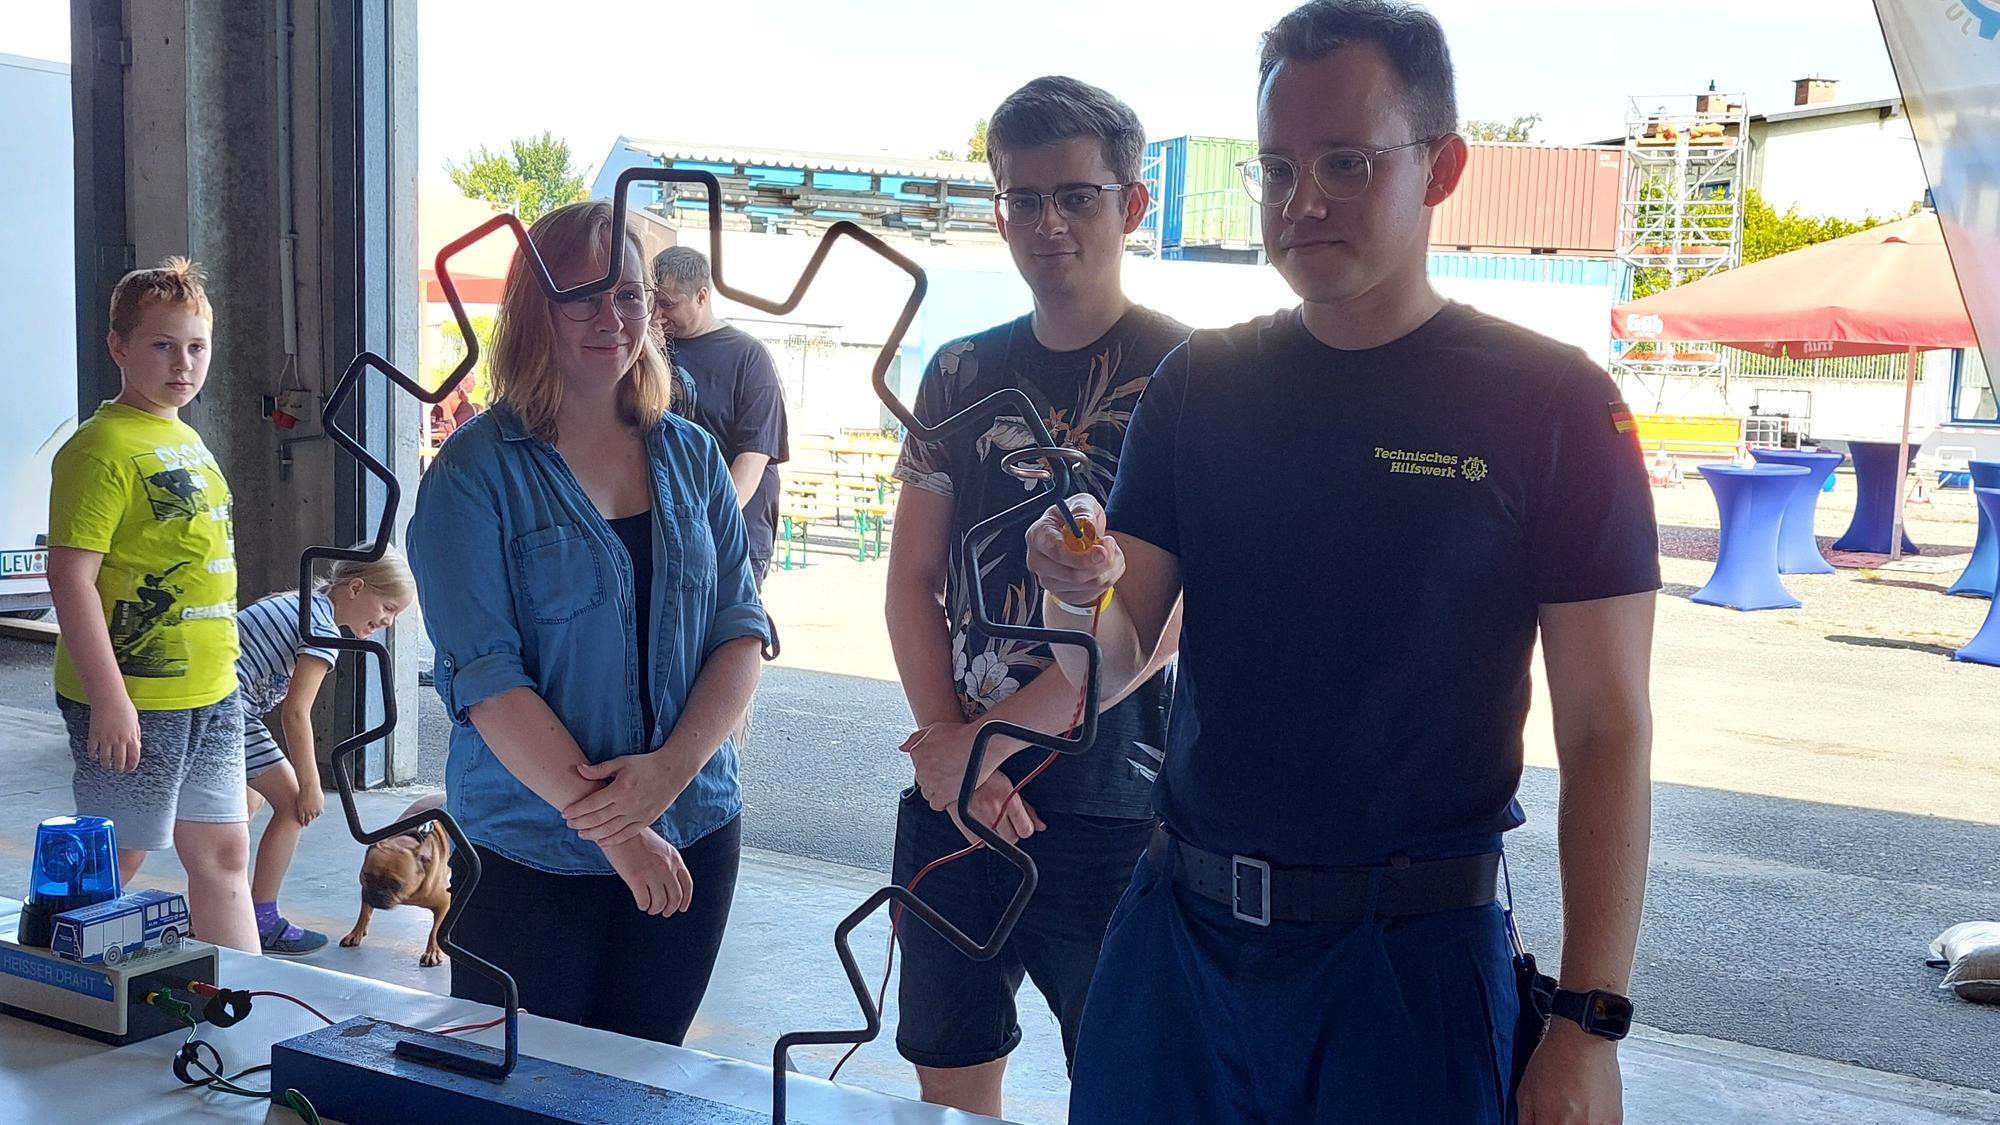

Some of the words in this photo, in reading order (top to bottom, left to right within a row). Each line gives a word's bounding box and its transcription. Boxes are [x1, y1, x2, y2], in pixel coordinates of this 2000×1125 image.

[1374, 447, 1458, 465] Technisches
[1390, 461, 1456, 478] Hilfswerk
[3, 554, 32, 573] LEV
[3, 954, 53, 979] HEISSER
[56, 967, 96, 991] DRAHT
